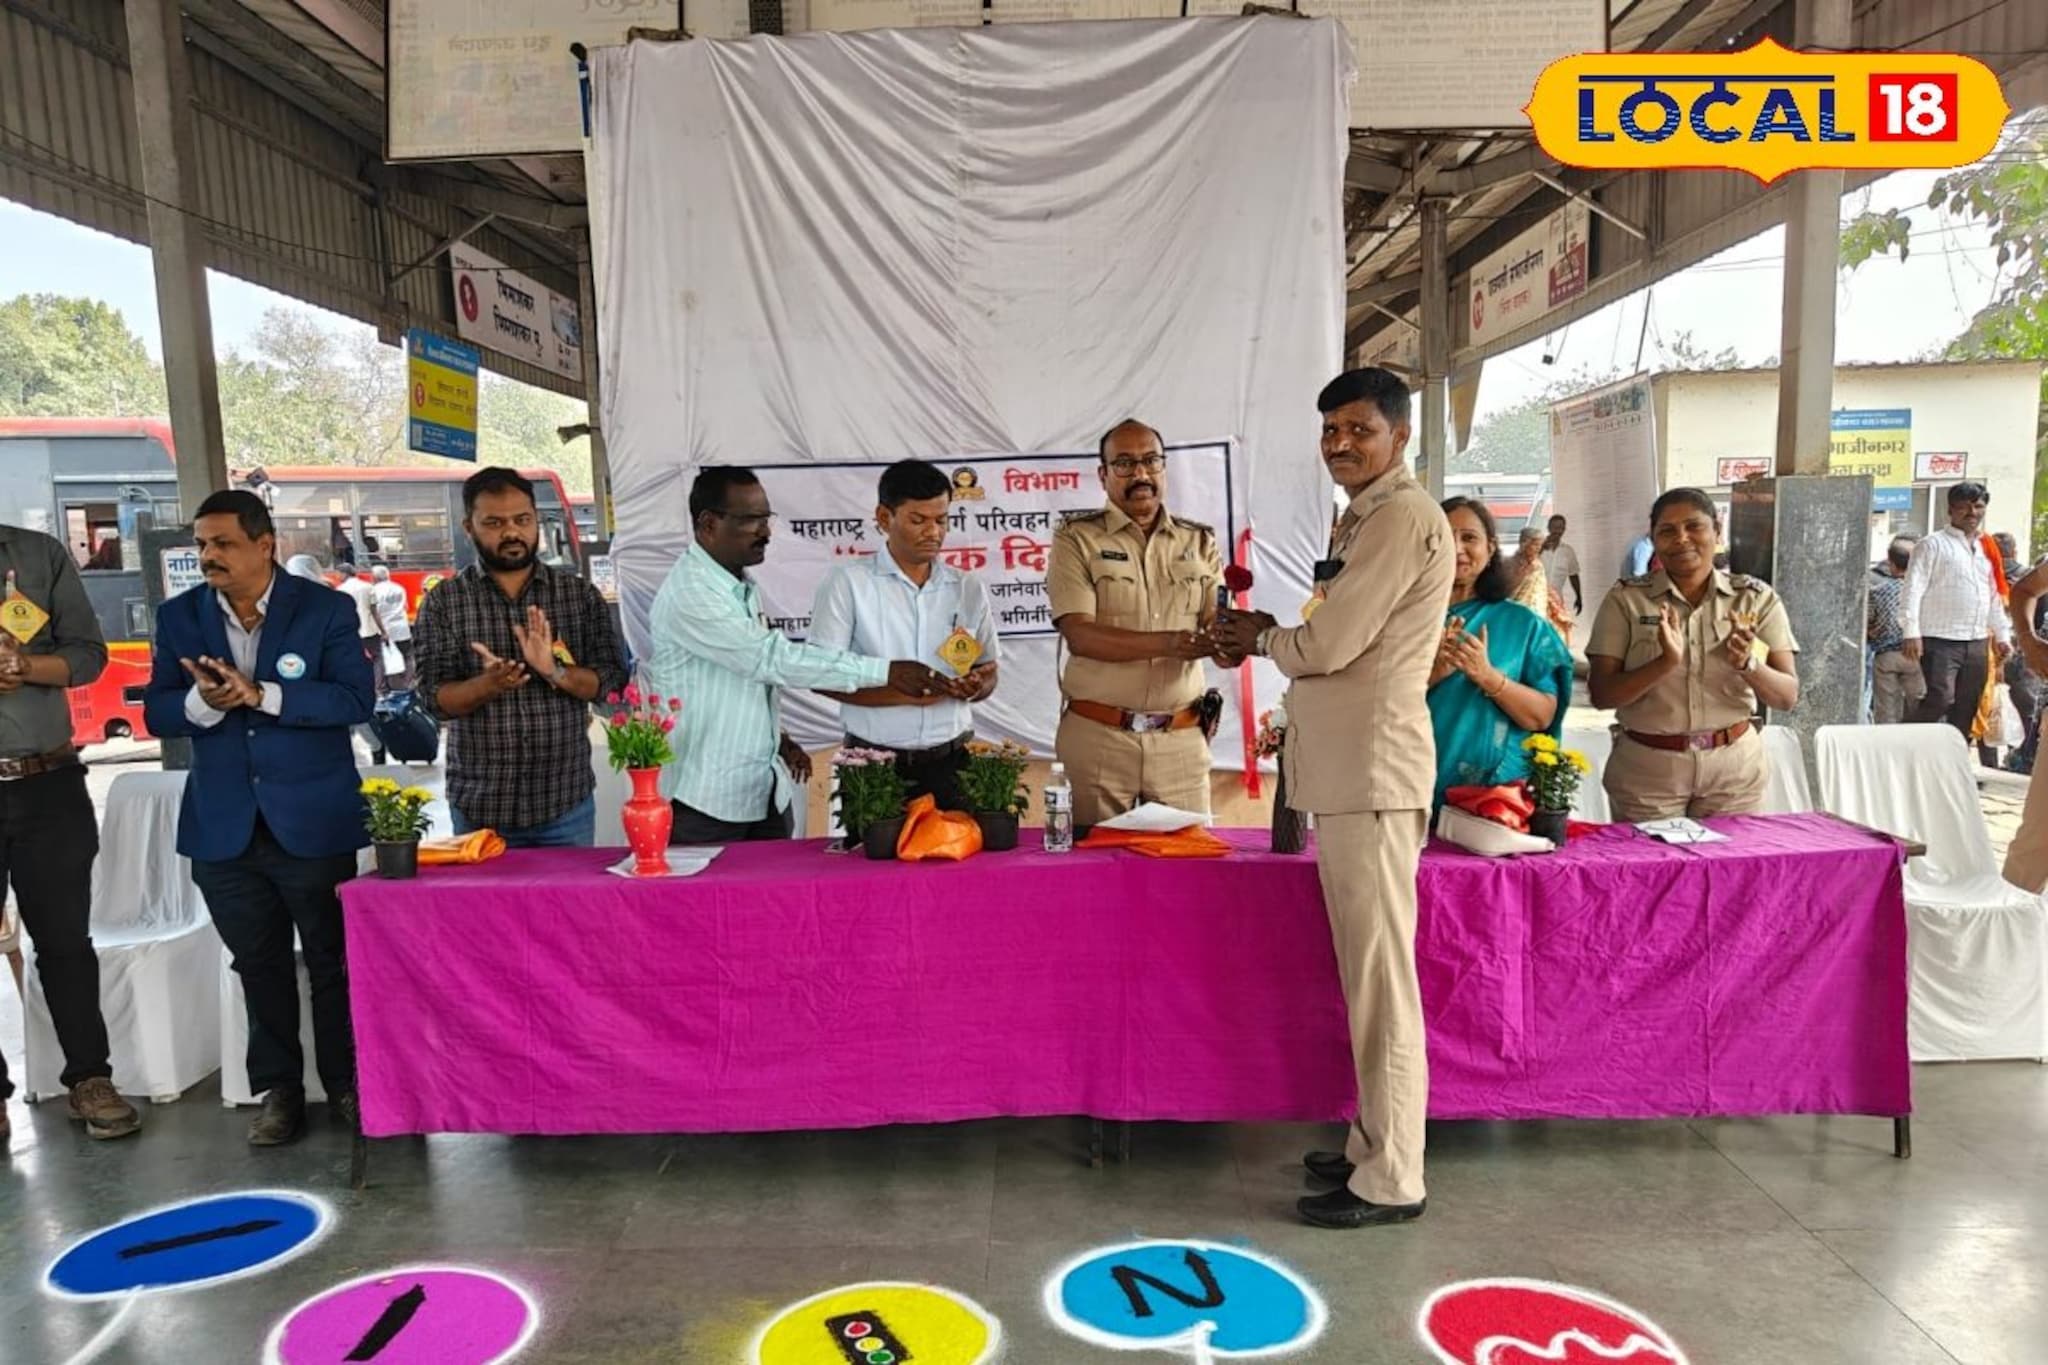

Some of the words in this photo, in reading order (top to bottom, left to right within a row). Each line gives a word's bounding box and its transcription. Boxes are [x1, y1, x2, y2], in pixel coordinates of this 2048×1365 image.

[1003, 467, 1079, 493] विभाग
[790, 518, 865, 541] महाराष्ट्र
[975, 507, 1050, 532] परिवहन
[167, 552, 198, 572] नाशि
[1000, 535, 1053, 571] दि
